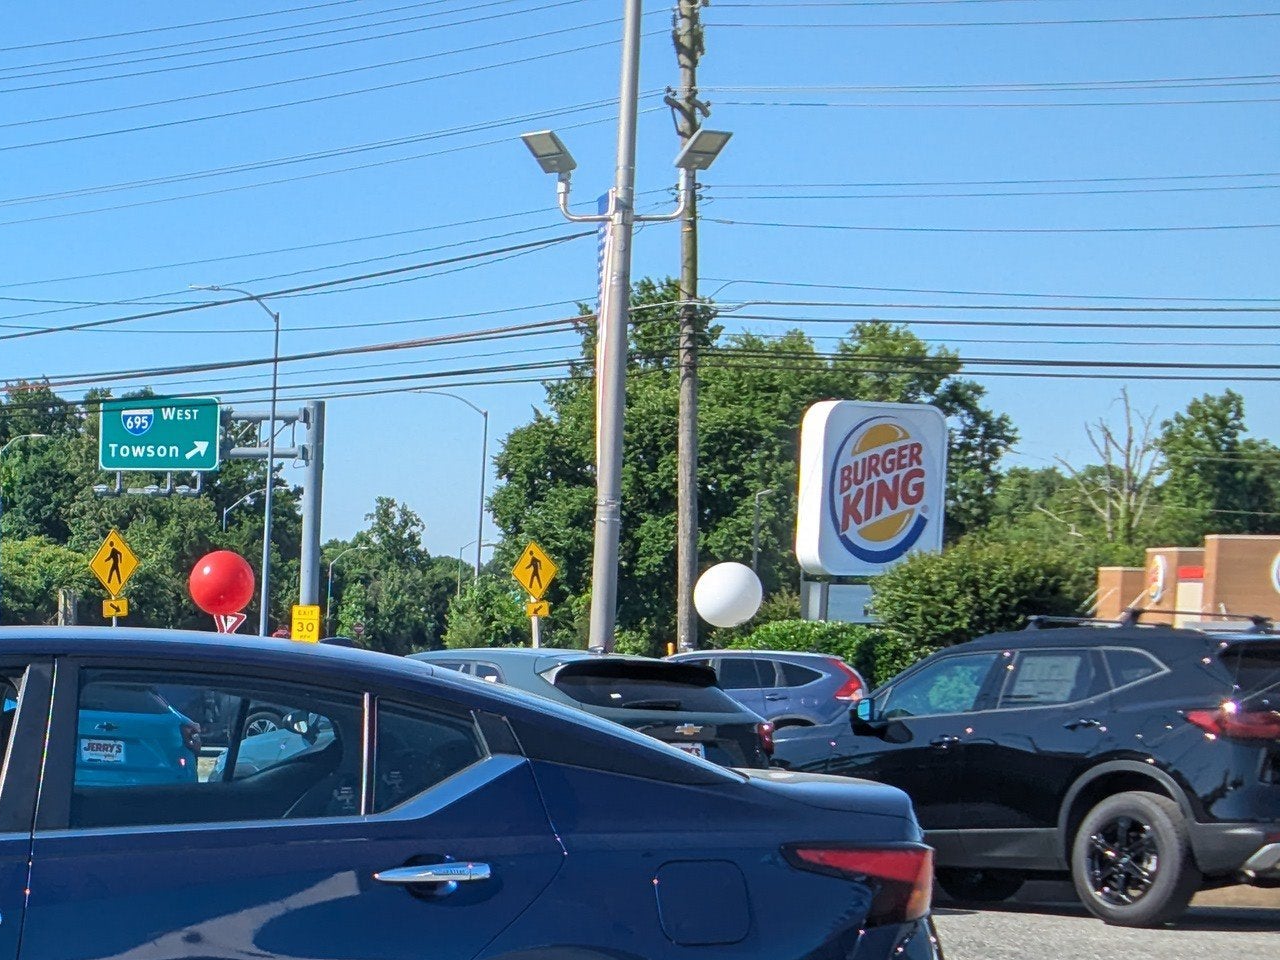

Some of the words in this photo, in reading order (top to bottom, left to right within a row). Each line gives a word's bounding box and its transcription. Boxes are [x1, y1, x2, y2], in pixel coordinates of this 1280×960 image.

[126, 416, 148, 430] 695
[161, 407, 199, 420] WEST
[109, 443, 179, 458] Towson
[839, 442, 923, 495] BURGER
[841, 468, 925, 533] KING
[296, 622, 315, 632] 30
[83, 742, 123, 753] JERRY'S
